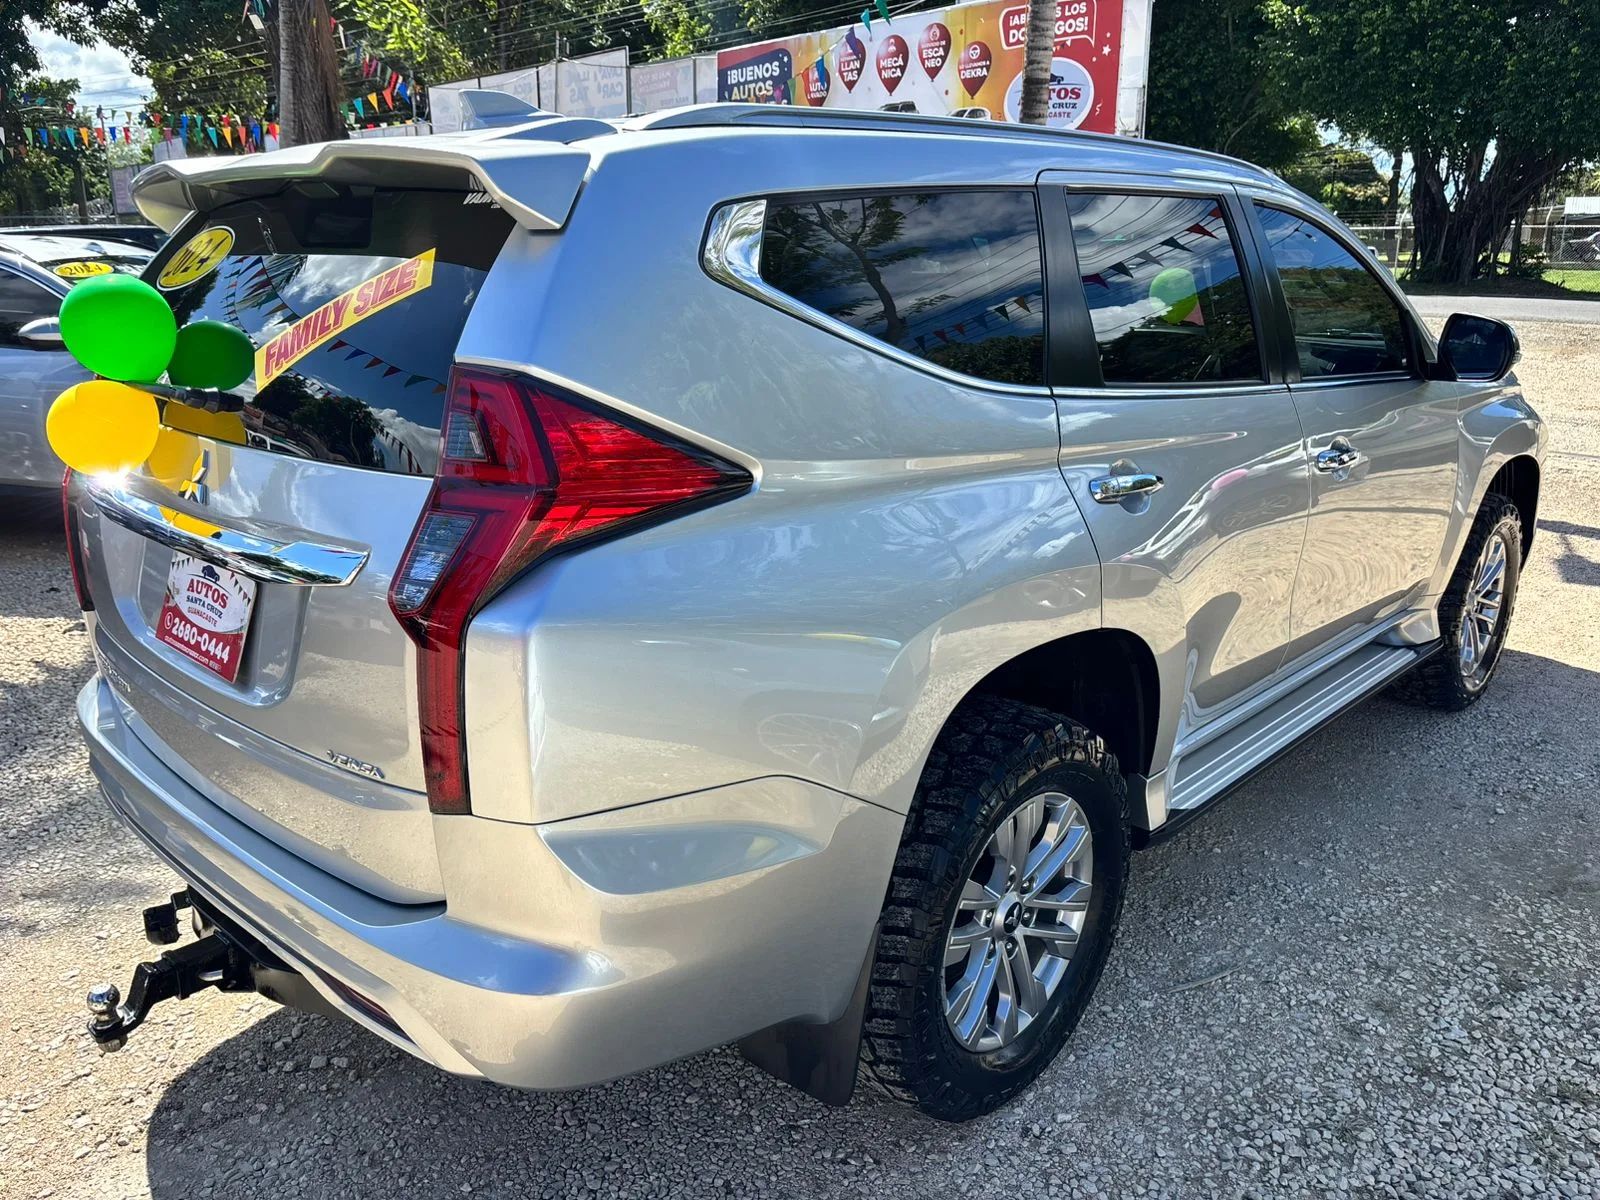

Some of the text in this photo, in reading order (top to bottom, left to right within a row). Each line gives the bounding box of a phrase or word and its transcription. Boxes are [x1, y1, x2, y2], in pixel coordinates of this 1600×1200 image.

[1065, 2, 1087, 16] LOS
[922, 47, 945, 58] ESCA
[841, 59, 860, 72] LLAN
[880, 54, 904, 68] MECÁ
[924, 57, 942, 68] NEO
[727, 61, 780, 85] ¡BUENOS
[842, 70, 858, 82] TAS
[881, 67, 901, 79] NICA
[960, 66, 988, 79] DEKRA
[731, 80, 773, 100] AUTOS
[1052, 102, 1078, 110] CRUZ
[264, 258, 422, 379] FAMILY SIZE
[187, 578, 229, 609] AUTOS
[186, 595, 223, 619] SANTA CRUZ
[187, 606, 217, 628] GUANACASTE
[171, 617, 231, 664] 2680-0444
